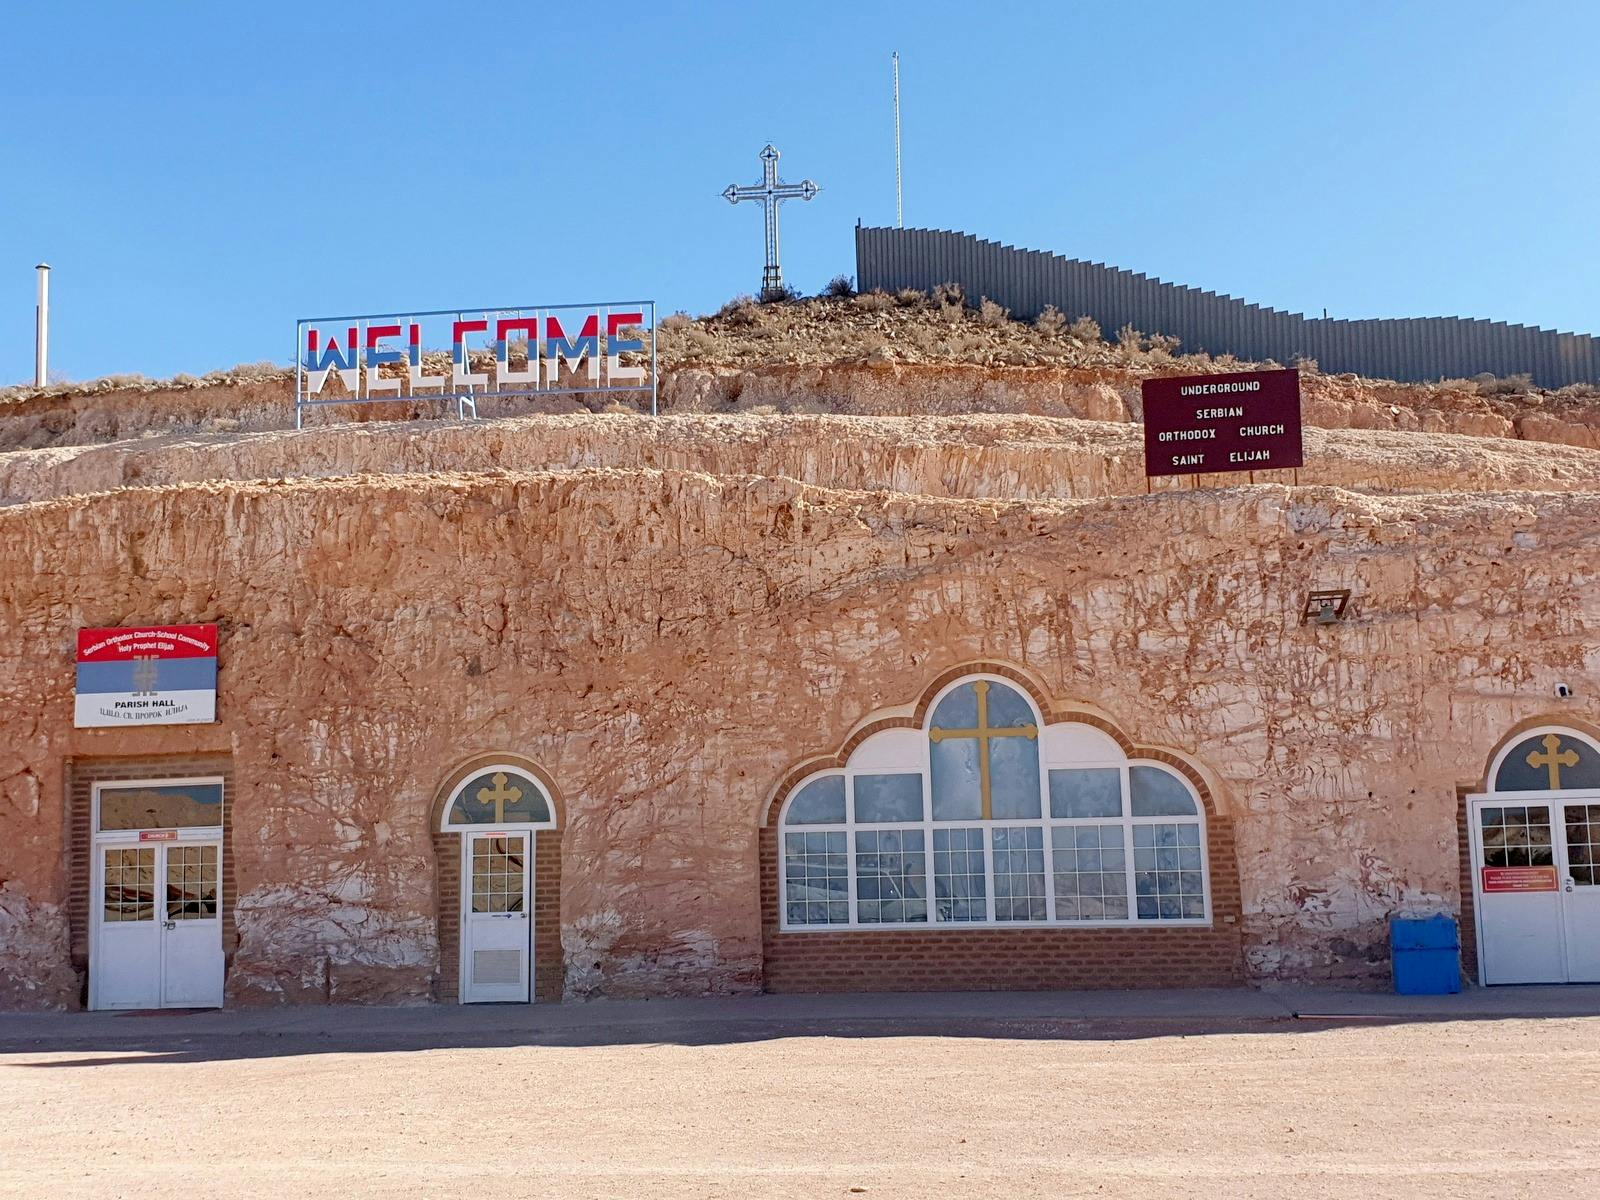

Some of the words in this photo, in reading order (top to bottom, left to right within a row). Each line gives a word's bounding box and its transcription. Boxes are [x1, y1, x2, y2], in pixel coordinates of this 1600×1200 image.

[307, 312, 644, 394] WELCOME
[1181, 381, 1261, 396] UNDERGROUND
[1196, 406, 1244, 419] SERBIAN
[1158, 428, 1217, 442] ORTHODOX
[1239, 424, 1285, 437] CHURCH
[1172, 454, 1205, 466] SAINT
[1229, 450, 1270, 463] ELIJAH
[83, 641, 106, 656] Serbian
[106, 633, 134, 646] Orthodox
[134, 630, 178, 640] Church-School
[178, 633, 210, 652] Community
[118, 644, 133, 653] Holy
[133, 641, 157, 651] Prophet
[157, 642, 175, 651] Elijah
[114, 700, 149, 709] PARISH
[152, 699, 176, 708] HALL
[135, 711, 163, 720] ПРОРОК
